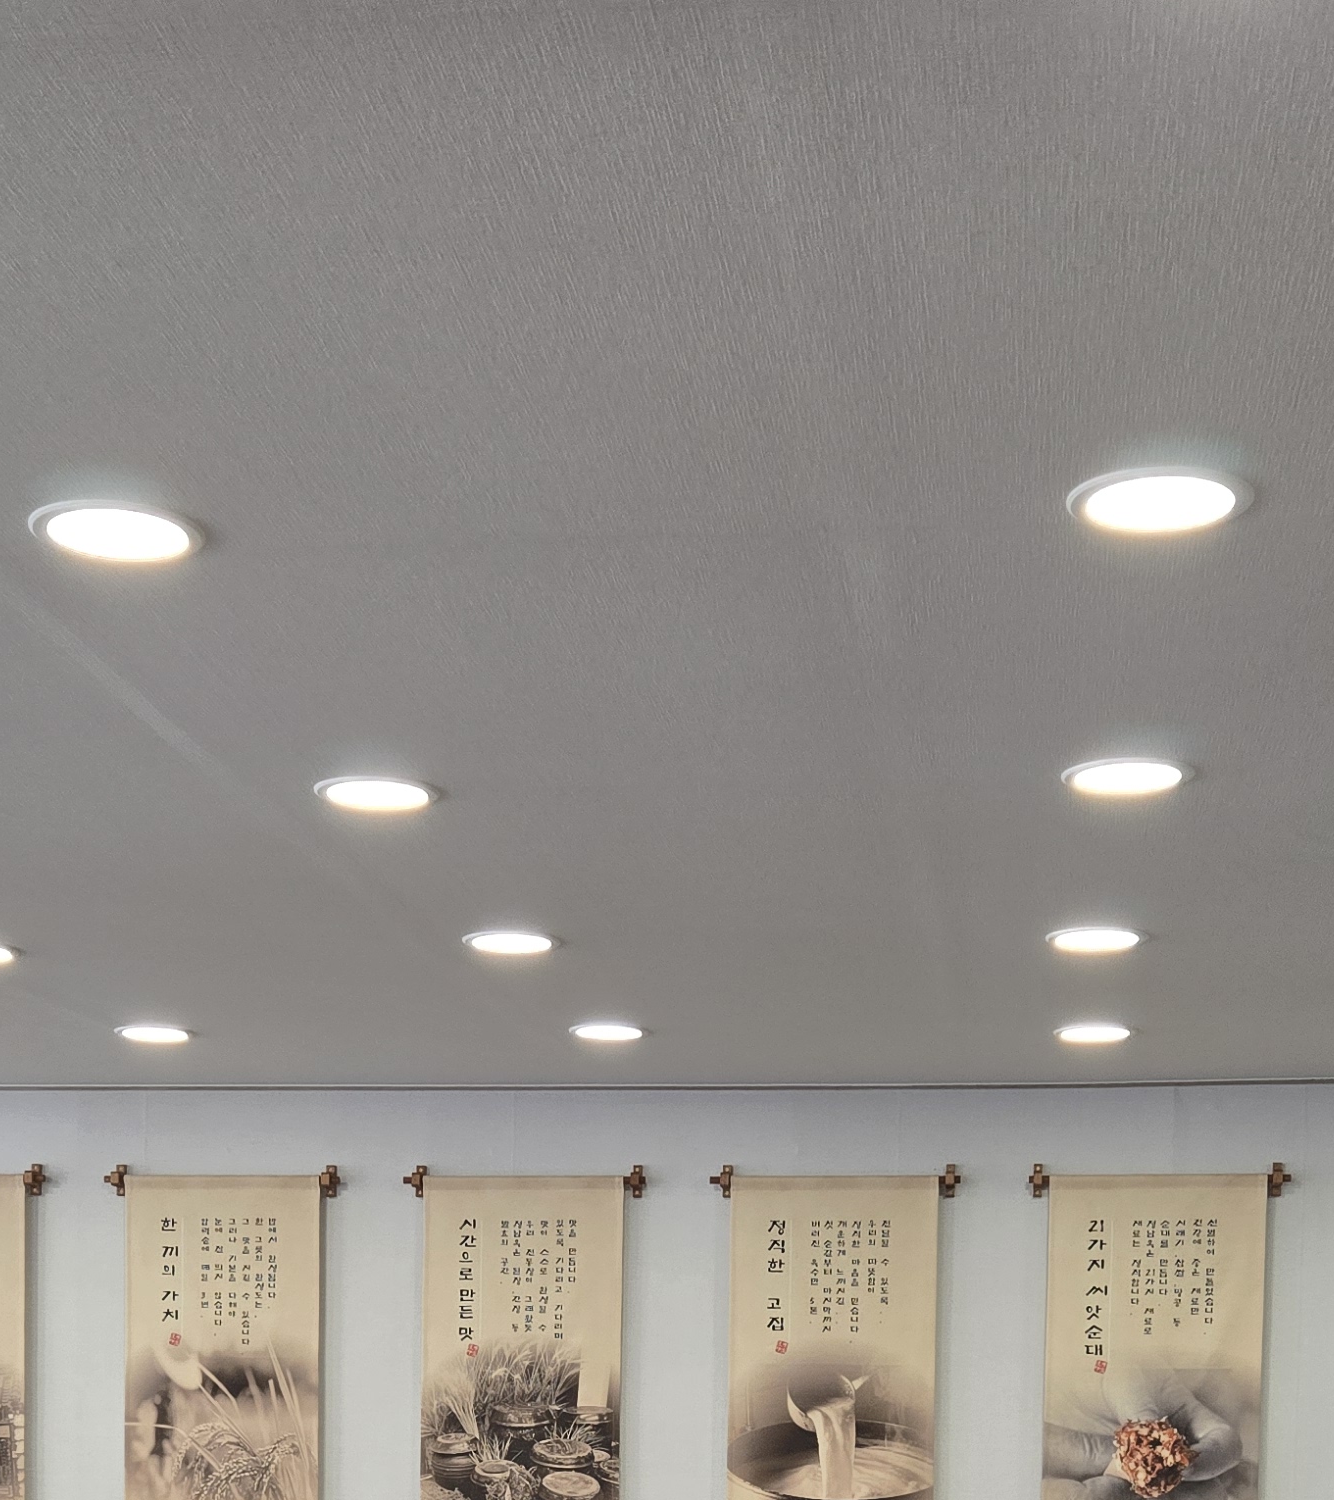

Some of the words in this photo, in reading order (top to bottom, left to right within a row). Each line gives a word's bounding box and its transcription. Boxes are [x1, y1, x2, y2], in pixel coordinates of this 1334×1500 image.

[161, 1218, 177, 1231] 한
[163, 1246, 178, 1276] 끼의
[459, 1219, 476, 1280] 시간으로
[768, 1220, 785, 1272] 정직한
[1088, 1220, 1106, 1271] 21가지
[162, 1291, 178, 1321] 가치
[459, 1289, 475, 1319] 만든
[767, 1298, 784, 1331] 고집
[459, 1327, 473, 1341] 맛
[1085, 1286, 1107, 1355] 씨앗순대
